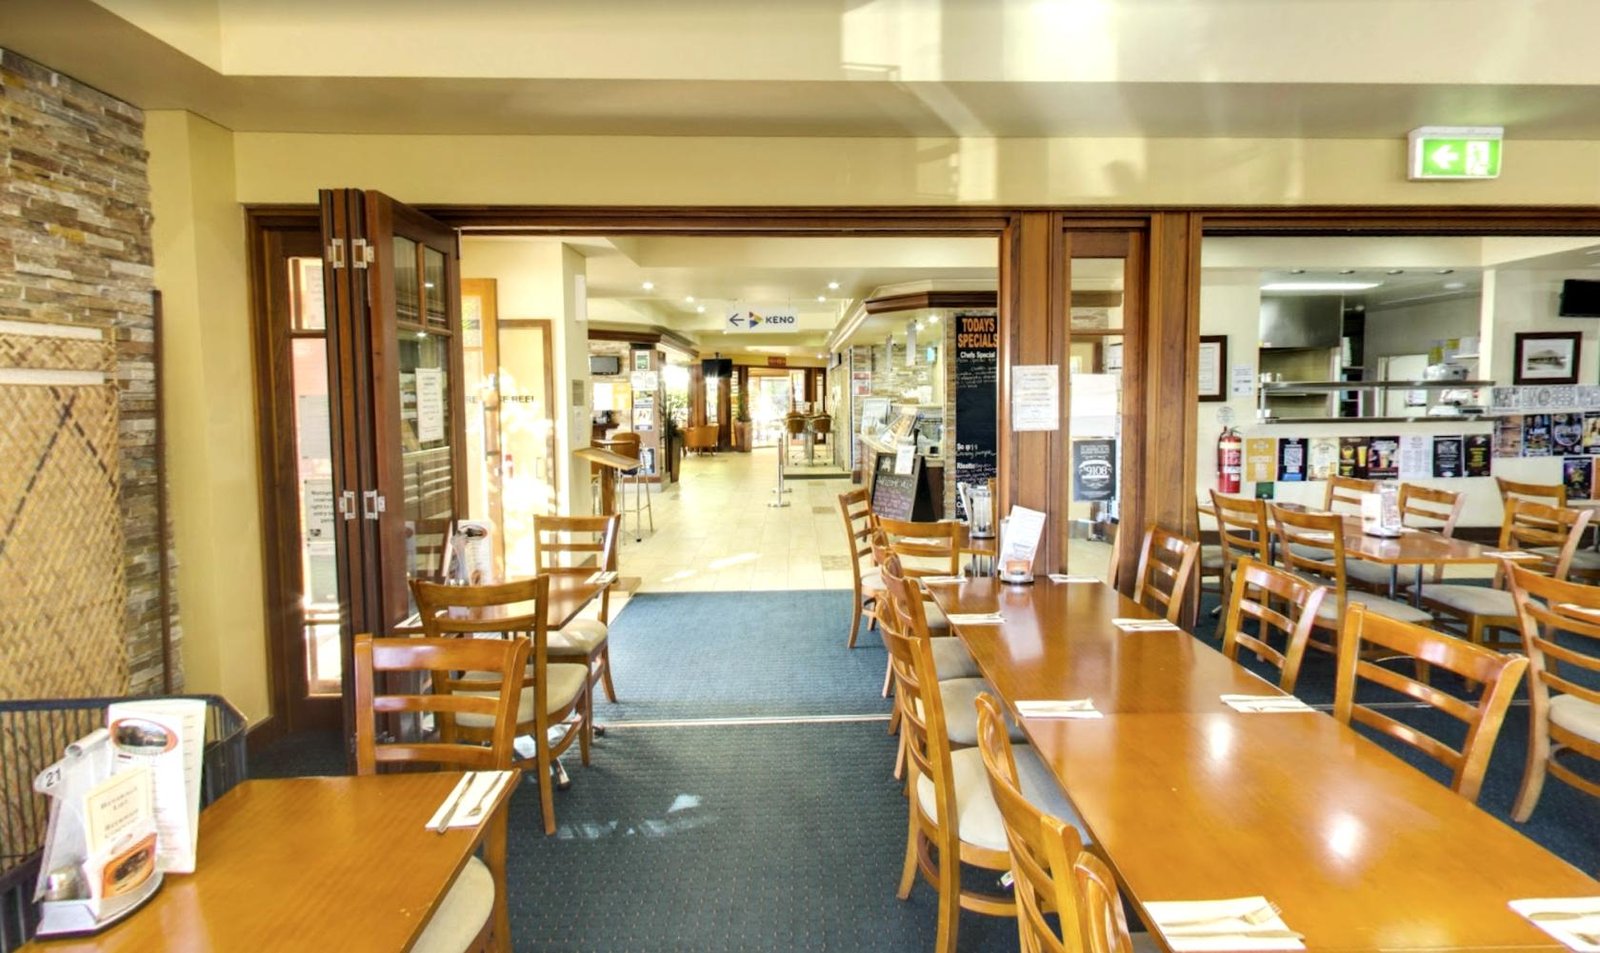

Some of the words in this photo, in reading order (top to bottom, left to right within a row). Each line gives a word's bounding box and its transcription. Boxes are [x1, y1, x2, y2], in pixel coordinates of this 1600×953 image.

[765, 316, 794, 324] KENO
[961, 318, 995, 332] TODAYS
[957, 333, 998, 348] SPECIALS
[46, 768, 62, 787] 21
